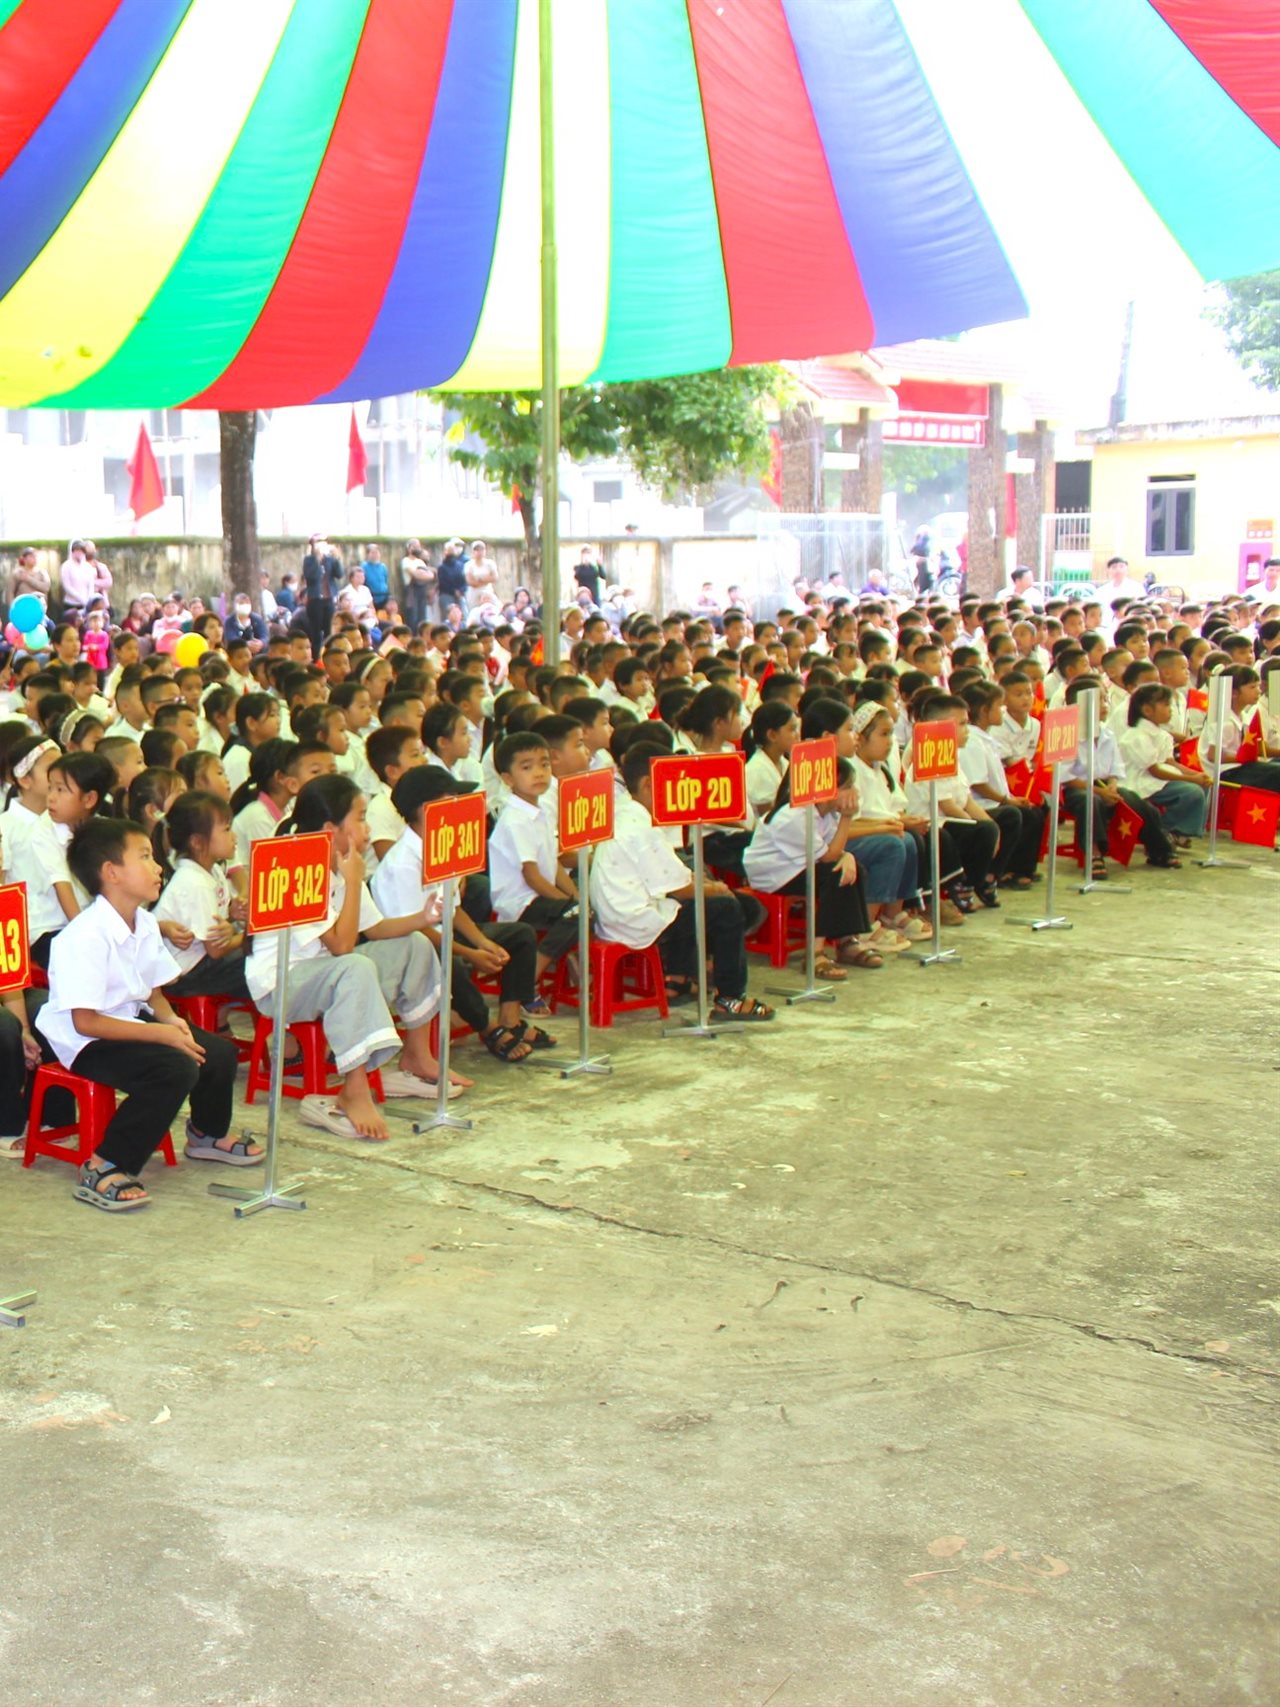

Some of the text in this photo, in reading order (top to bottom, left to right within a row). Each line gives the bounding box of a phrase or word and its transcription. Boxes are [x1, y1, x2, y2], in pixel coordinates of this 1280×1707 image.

[918, 734, 954, 768] LỚP 2A2
[1047, 716, 1076, 753] LỚP 2A1
[666, 771, 731, 811] LỚP 2D
[793, 753, 833, 798] LỚP 2A3
[568, 790, 606, 834] LỚP 2H
[431, 817, 479, 865] LỚP 3A1
[258, 858, 324, 912] LỚP 3A2
